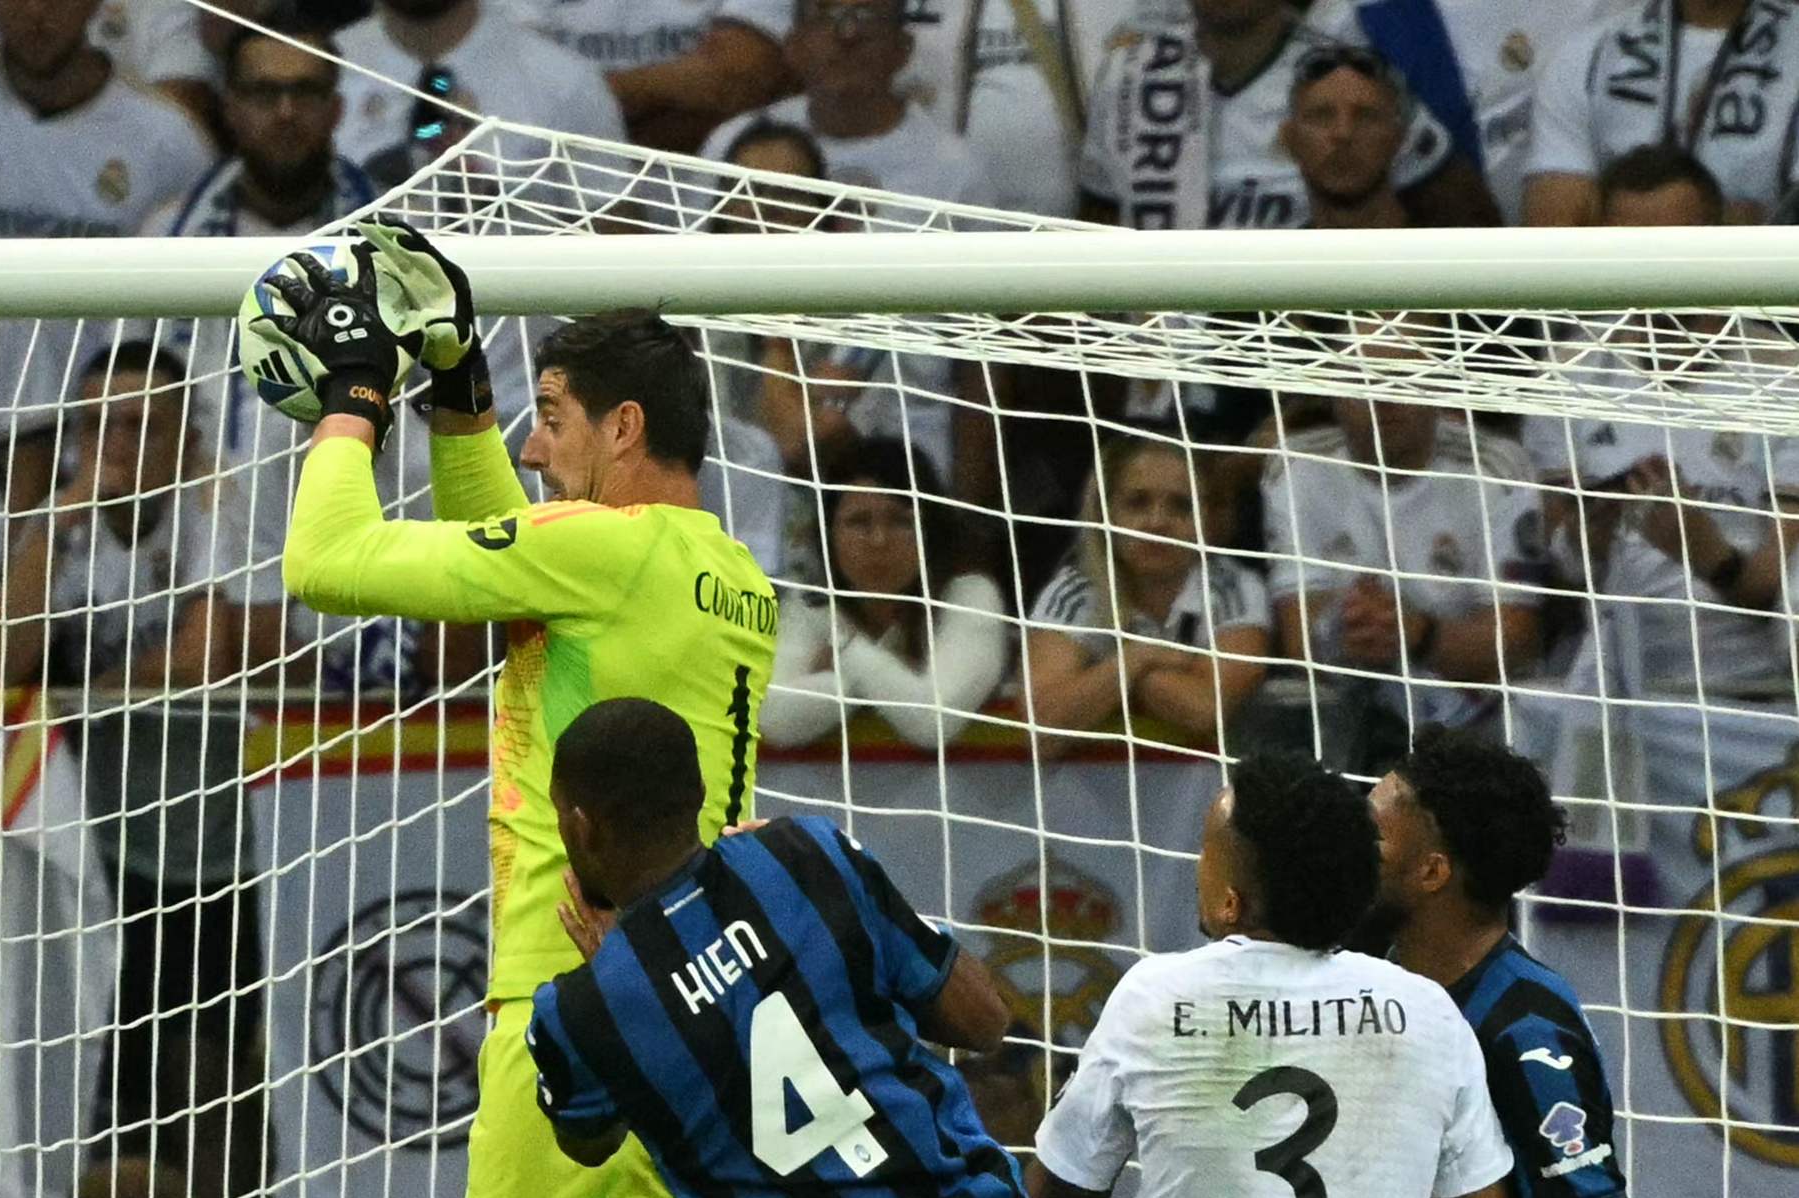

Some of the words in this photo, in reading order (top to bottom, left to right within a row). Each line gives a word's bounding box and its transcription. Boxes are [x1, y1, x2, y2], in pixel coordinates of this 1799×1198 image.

[1130, 34, 1186, 230] ADRID
[694, 570, 779, 638] COURTOI
[723, 664, 752, 833] 1
[749, 990, 890, 1178] 4
[1173, 1001, 1208, 1037] E.
[1227, 989, 1407, 1037] MILITÃO
